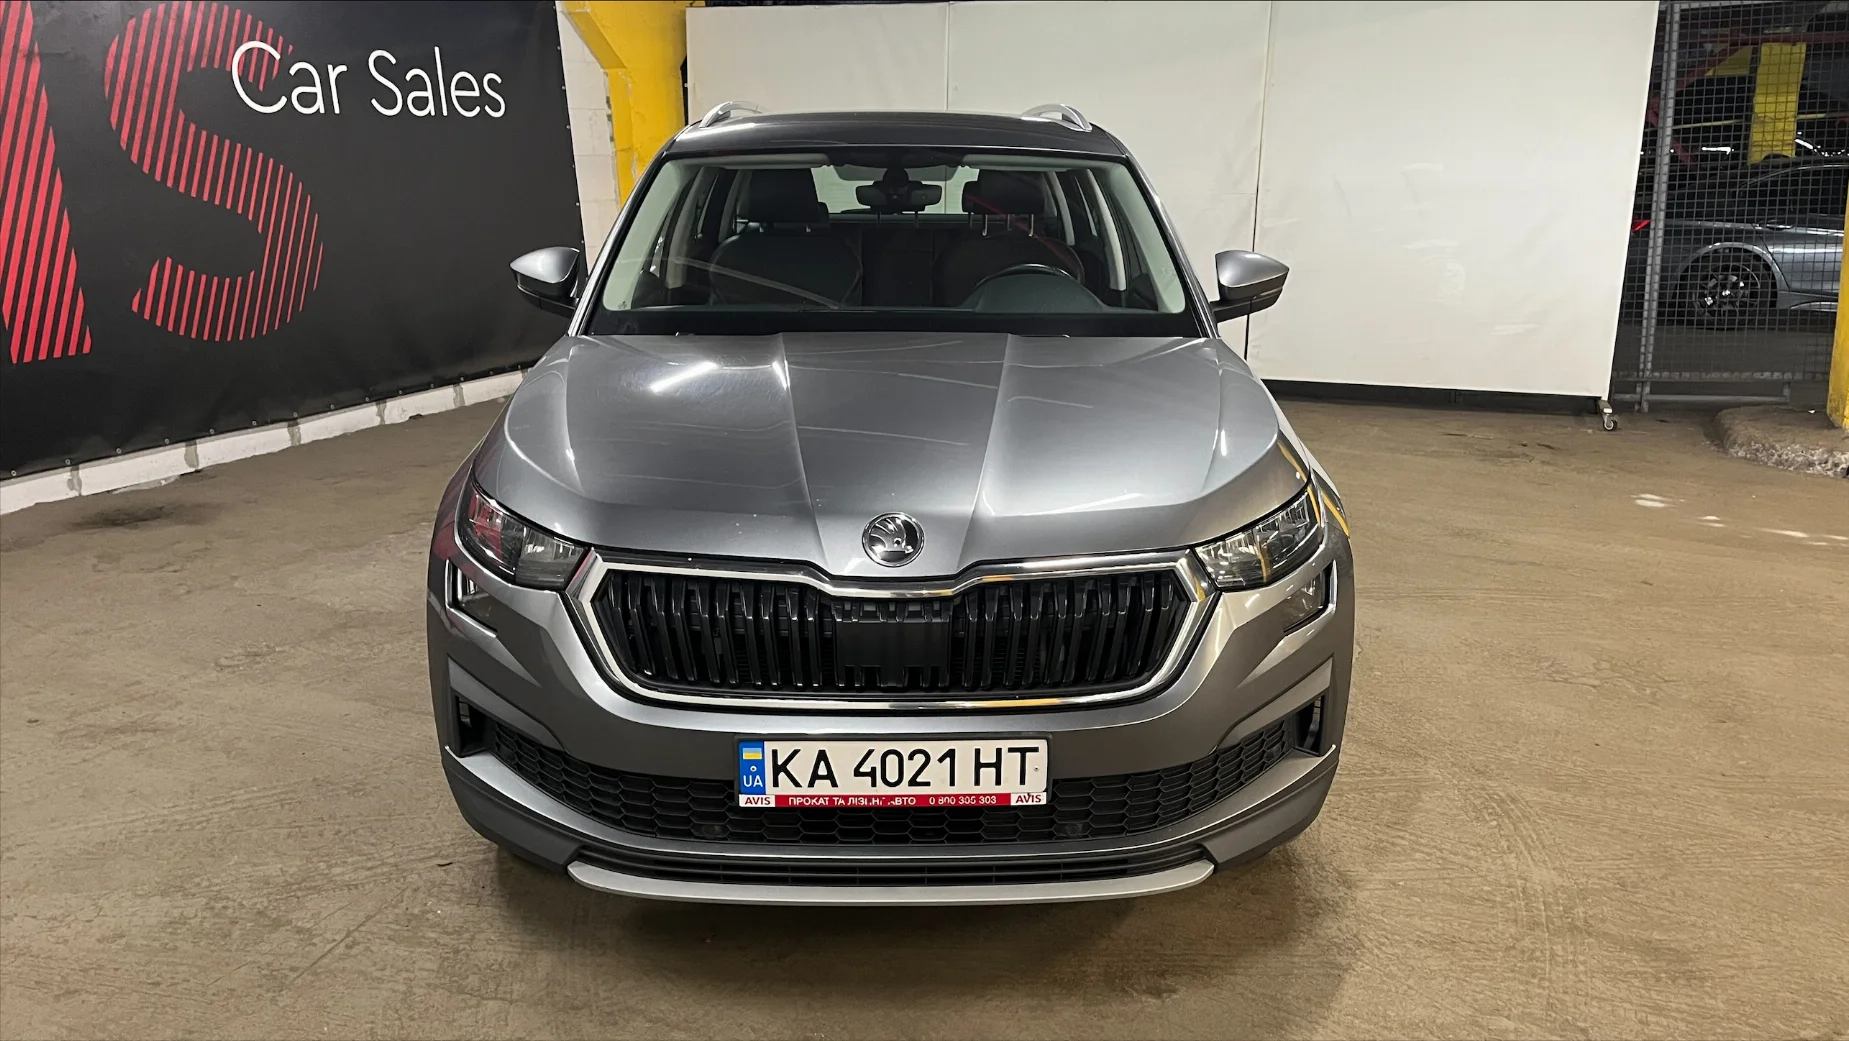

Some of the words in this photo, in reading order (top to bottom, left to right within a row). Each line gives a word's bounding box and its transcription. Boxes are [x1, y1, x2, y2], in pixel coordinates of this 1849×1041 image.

[231, 40, 348, 115] Car
[367, 46, 506, 118] Sales
[771, 748, 839, 788] KA
[853, 748, 956, 788] 4021
[973, 746, 1040, 787] HT
[743, 775, 764, 788] UA
[744, 796, 771, 806] AVIS
[788, 796, 830, 806] ПРОКАТ
[832, 796, 846, 806] ТА
[928, 796, 936, 805] 0
[938, 795, 956, 805] 800
[958, 795, 977, 805] 305
[979, 795, 997, 804] 303
[1015, 794, 1042, 804] AVIS
